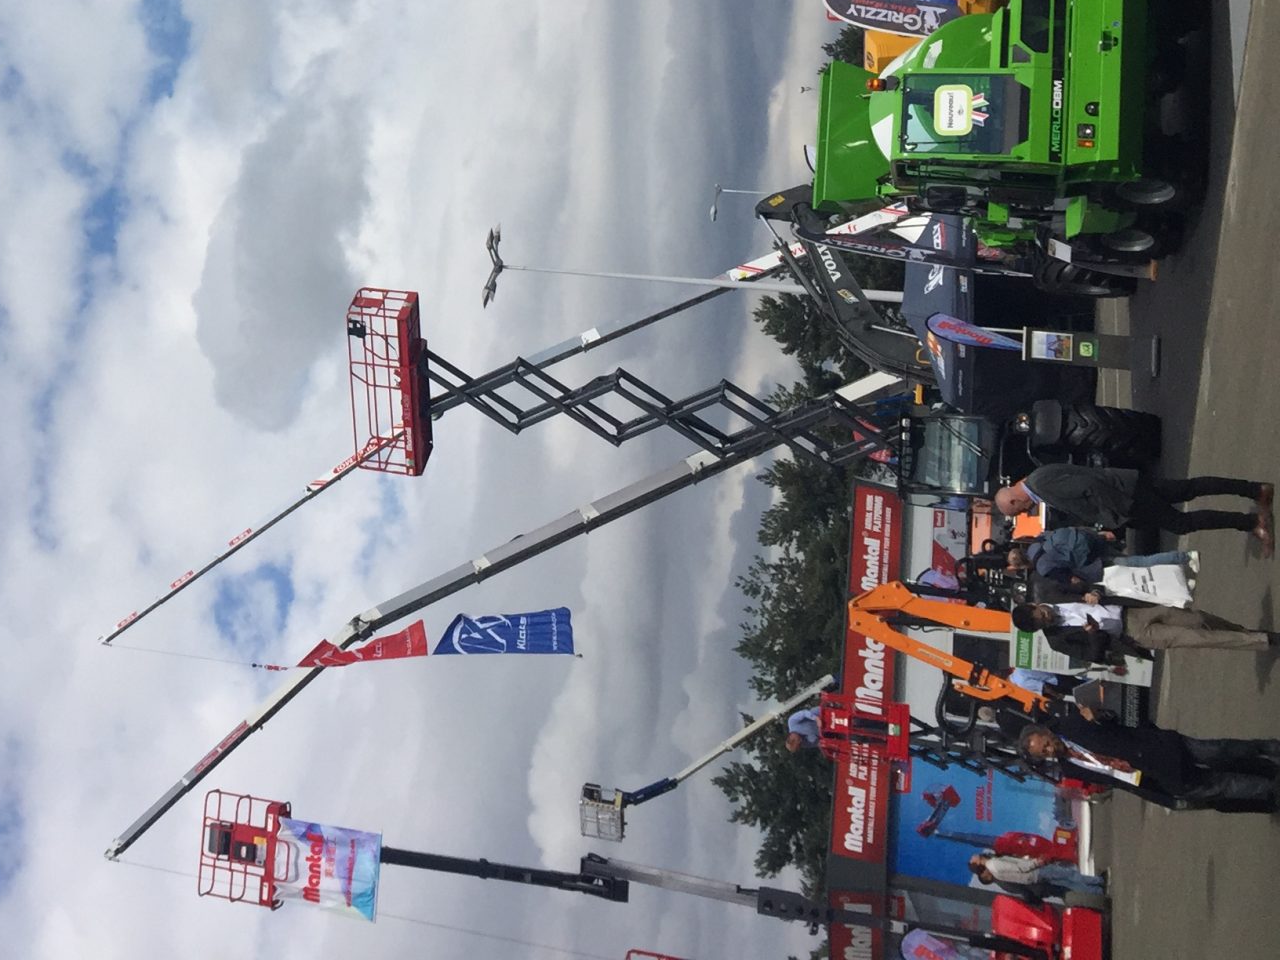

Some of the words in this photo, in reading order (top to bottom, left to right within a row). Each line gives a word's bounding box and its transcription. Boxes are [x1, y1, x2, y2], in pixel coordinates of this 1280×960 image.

[815, 241, 843, 282] VOLV
[861, 537, 881, 591] Mantall
[843, 785, 867, 853] Mantall
